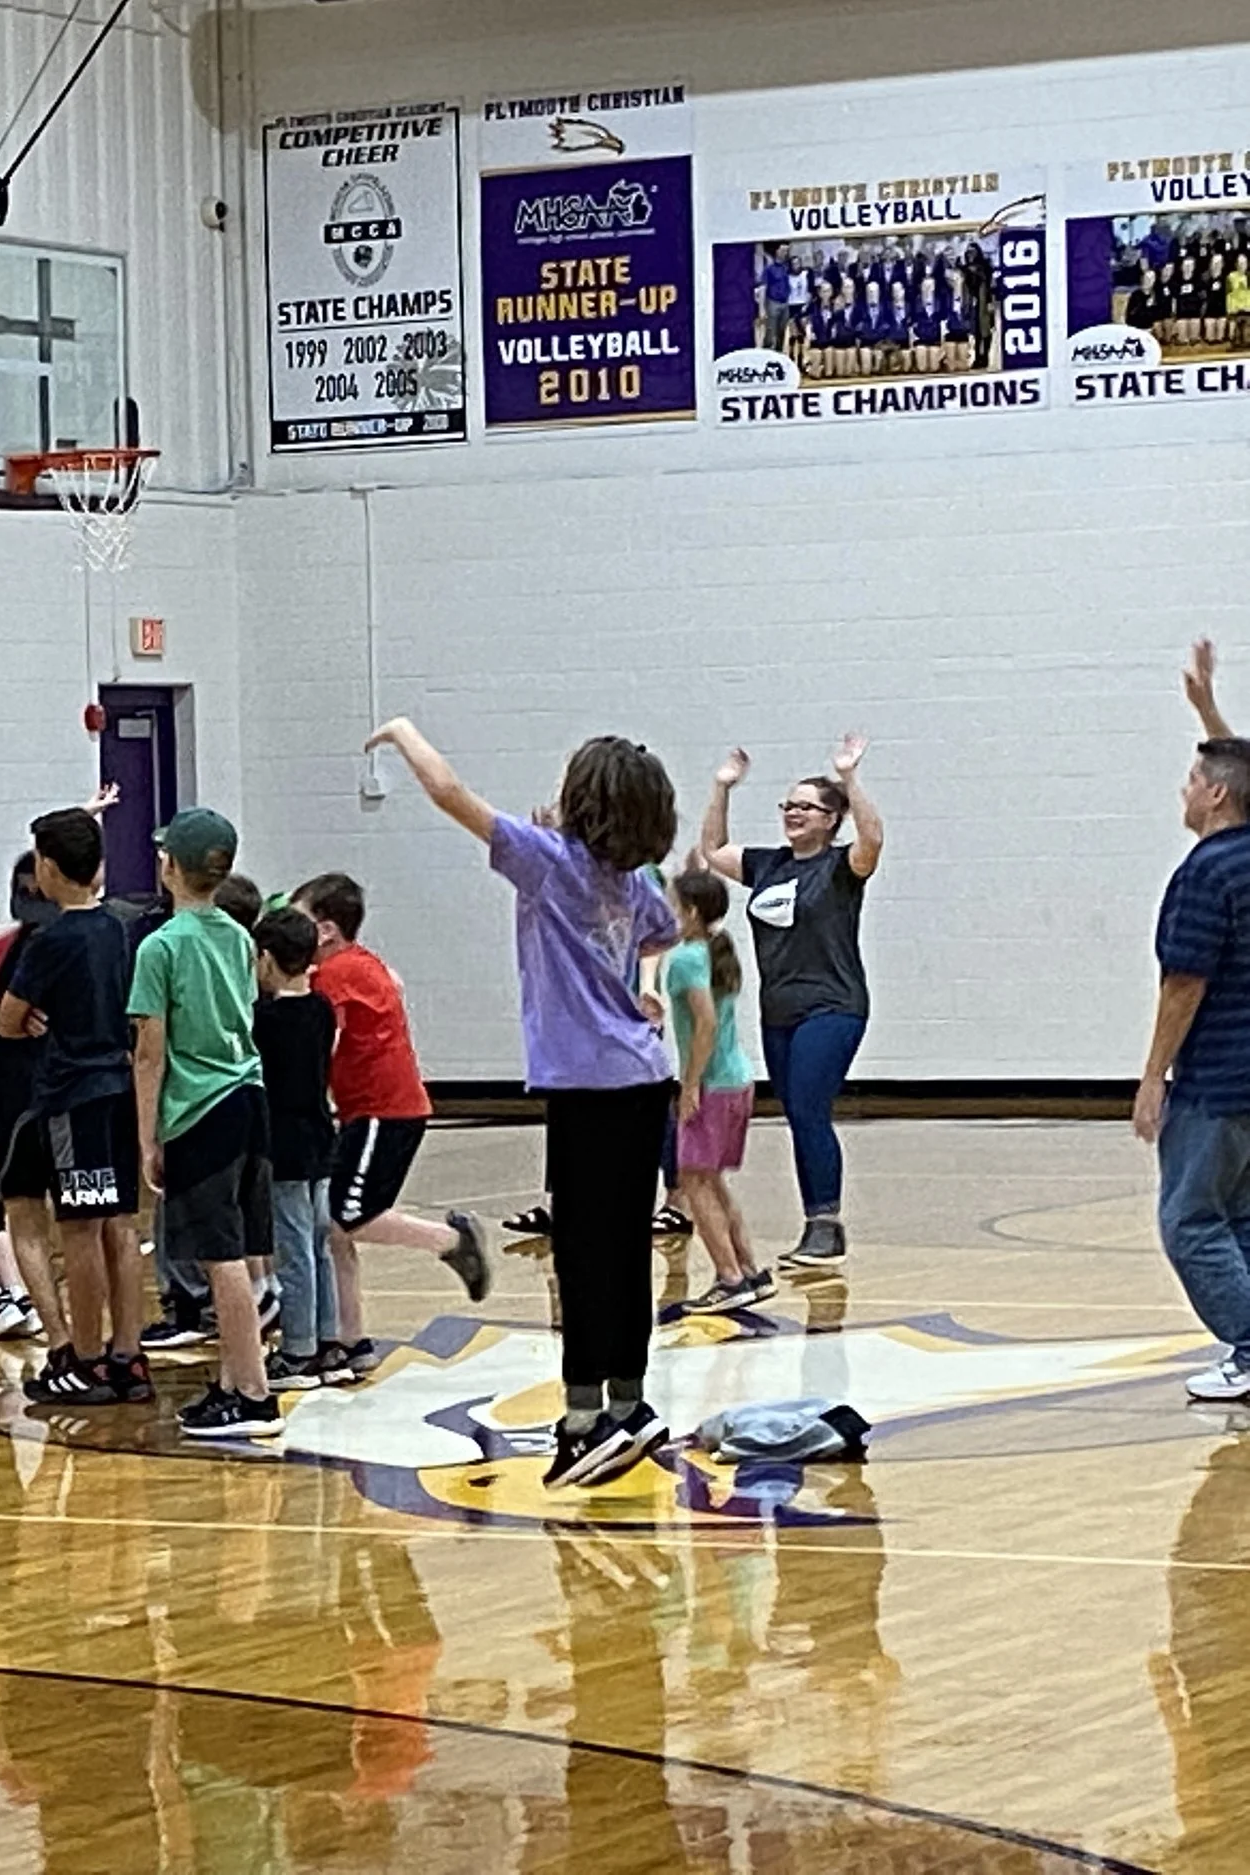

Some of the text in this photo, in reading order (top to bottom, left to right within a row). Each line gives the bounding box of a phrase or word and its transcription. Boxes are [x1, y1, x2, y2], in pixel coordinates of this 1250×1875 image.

[587, 85, 685, 111] CHRISTIAN
[279, 117, 443, 150] COMPETITIVE
[322, 144, 400, 167] CHEER
[790, 198, 962, 231] VOLLEYBALL
[541, 256, 631, 289] STATE
[278, 289, 453, 326] STATE CHAMPS
[496, 285, 678, 324] RUNNER-UP
[1002, 238, 1043, 357] 2016
[285, 329, 448, 369] 1999 2002 2003
[497, 328, 680, 364] VOLLEYBALL
[315, 368, 418, 403] 2004 2005
[539, 365, 641, 405] 2010
[1075, 364, 1250, 400] STATE CH
[721, 378, 1040, 423] STATE CHAMPIONS
